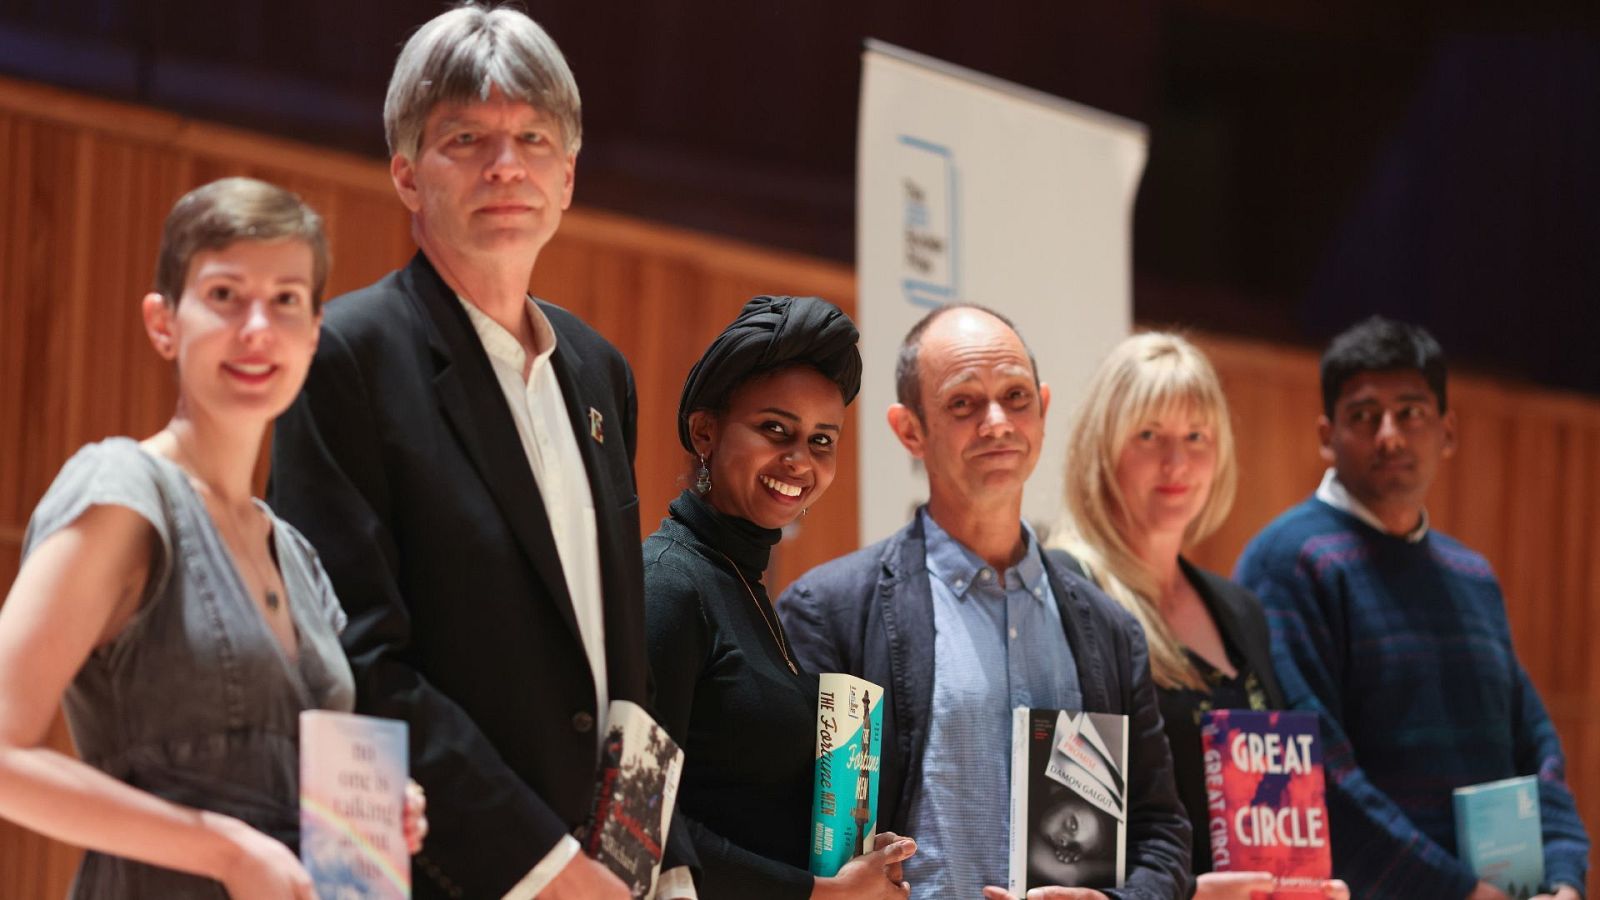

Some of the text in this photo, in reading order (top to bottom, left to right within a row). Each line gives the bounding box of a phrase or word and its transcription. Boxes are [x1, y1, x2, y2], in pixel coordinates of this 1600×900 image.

[820, 691, 838, 817] THE Fortune MEN
[846, 743, 880, 772] Fortune
[1063, 742, 1096, 769] PROMISE
[1231, 732, 1313, 775] GREAT
[855, 776, 868, 800] MEN
[1049, 764, 1114, 808] DAMON GALGUT
[1204, 749, 1230, 873] GREAT CIRCL
[1234, 805, 1325, 848] CIRCLE
[814, 821, 825, 856] MOHAMED
[823, 826, 834, 852] NADIFA
